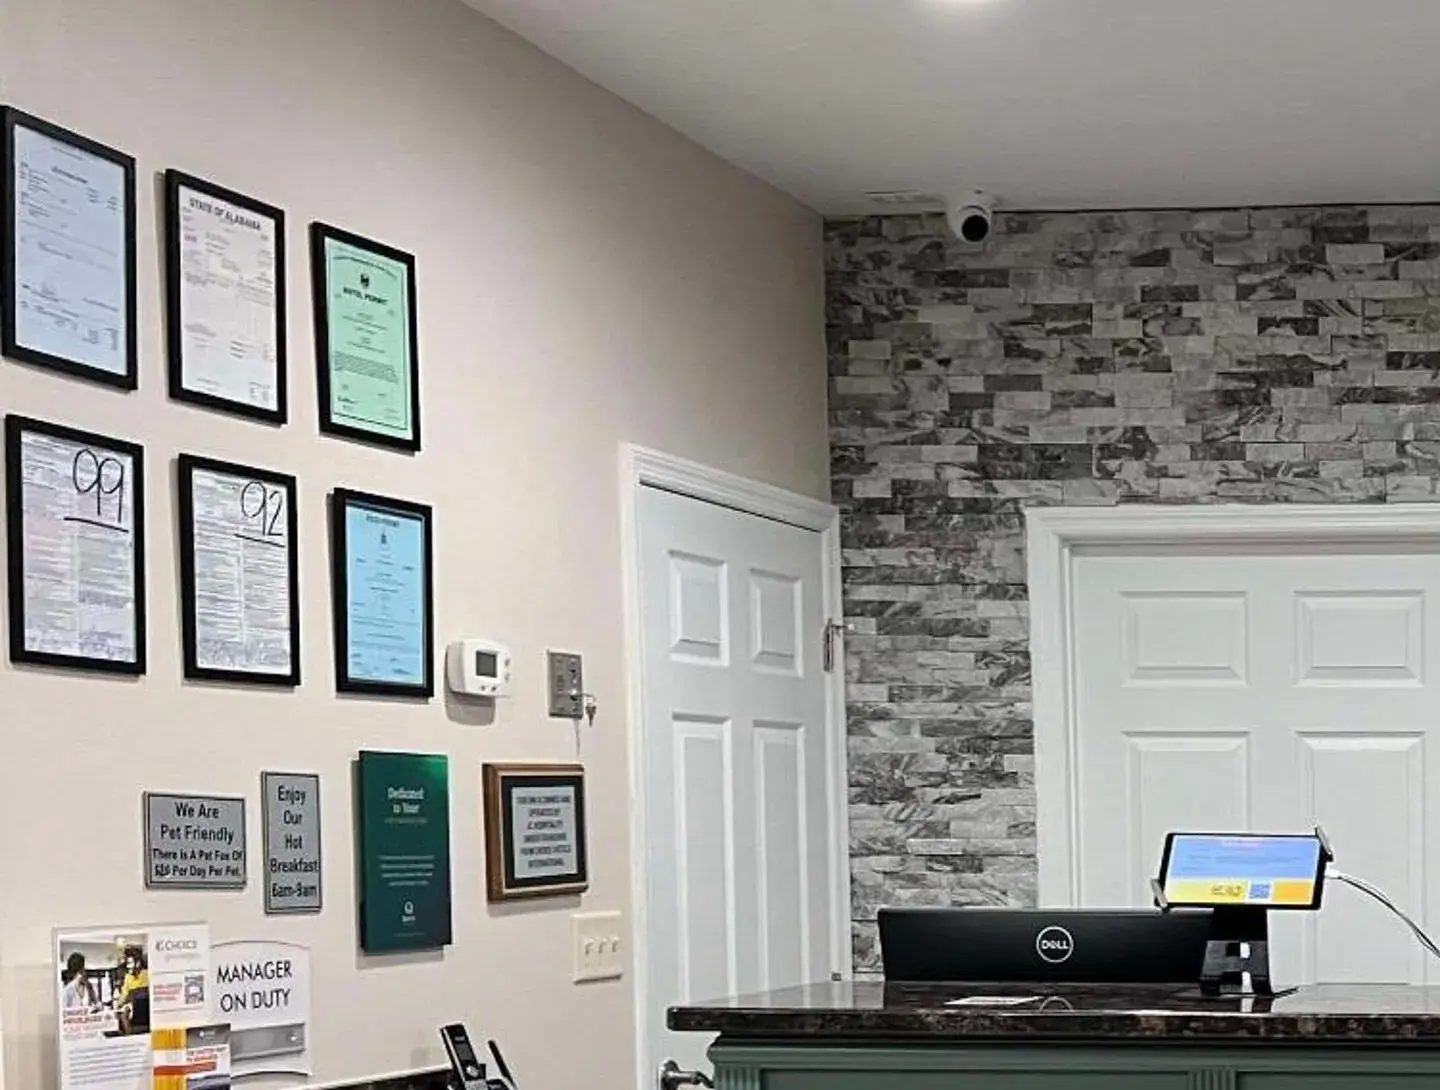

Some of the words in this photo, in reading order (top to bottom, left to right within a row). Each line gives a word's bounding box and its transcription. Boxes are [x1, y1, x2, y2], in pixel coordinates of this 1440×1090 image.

[278, 785, 306, 805] Enjoy
[174, 802, 194, 818] We
[198, 803, 219, 818] Are
[283, 810, 302, 824] Our
[160, 824, 181, 840] Pet
[184, 825, 234, 845] Friendly
[270, 858, 320, 873] Breakfast
[1041, 940, 1069, 949] DELL
[216, 960, 293, 985] MANAGER
[220, 992, 247, 1013] ON
[251, 988, 291, 1010] DUTY
